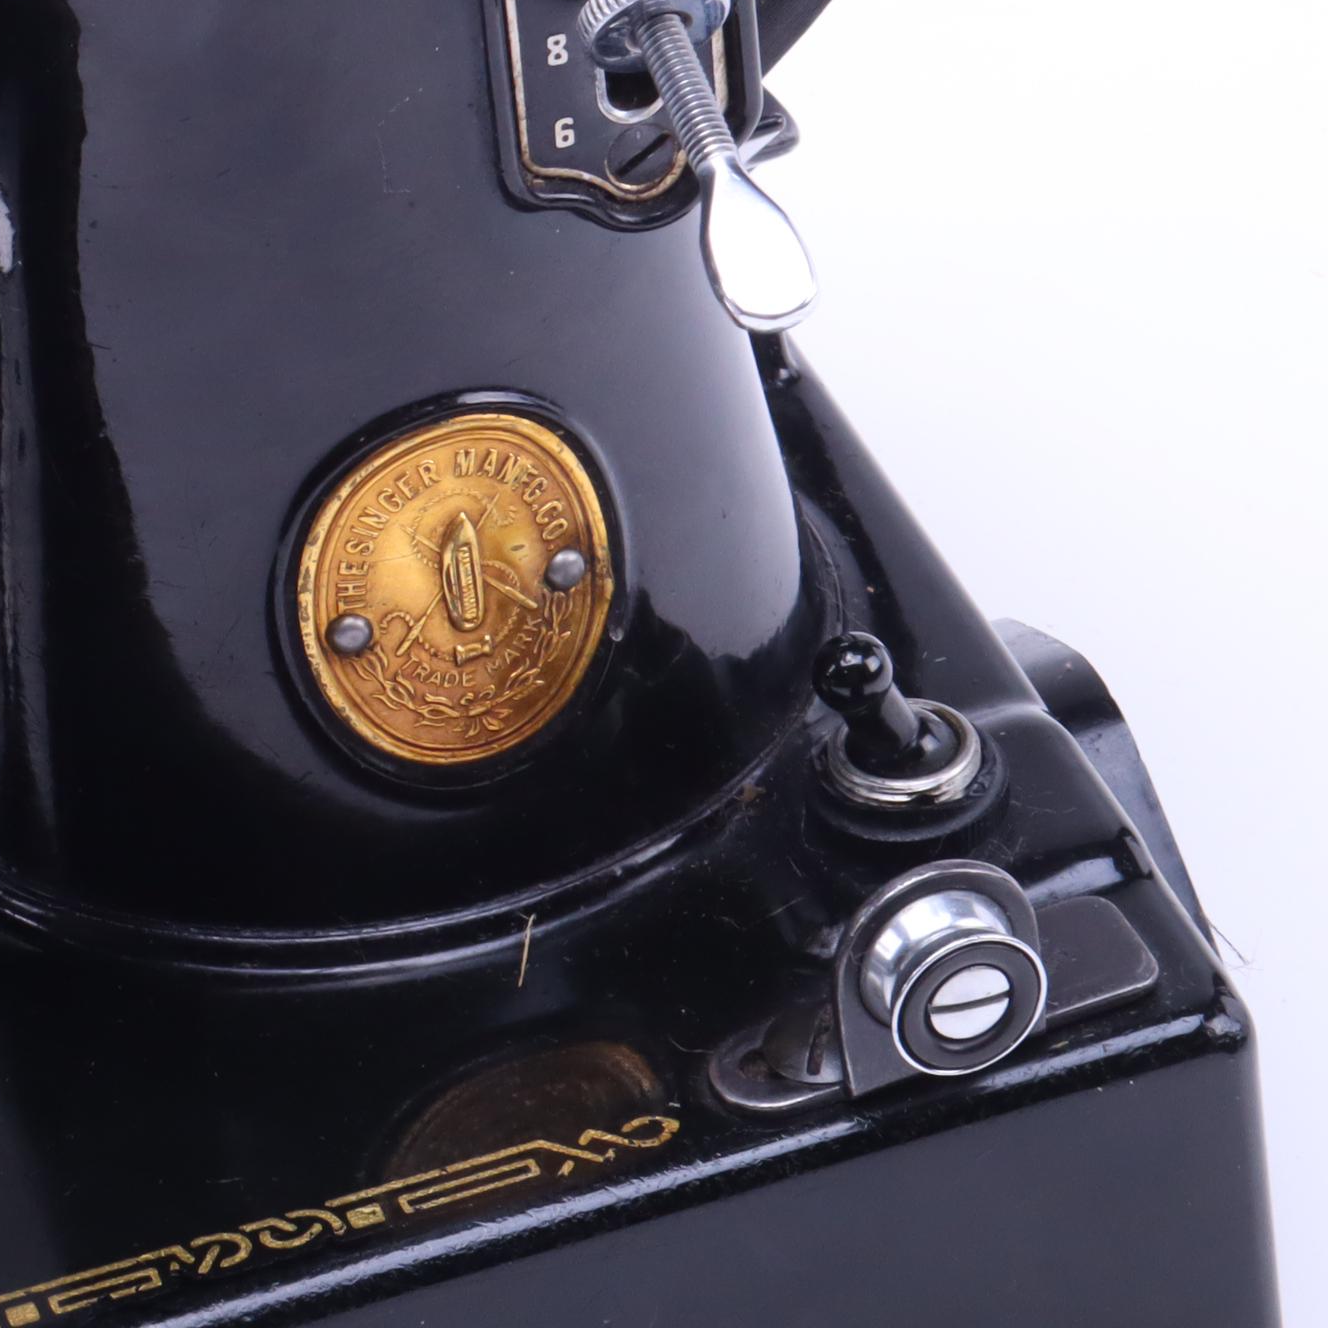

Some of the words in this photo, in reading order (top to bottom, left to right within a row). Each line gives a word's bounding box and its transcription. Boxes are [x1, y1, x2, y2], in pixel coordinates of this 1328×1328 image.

[547, 33, 568, 66] 8
[554, 117, 575, 149] 6
[345, 459, 441, 556] SINGER
[336, 560, 370, 613] THE
[402, 651, 476, 687] TRADE
[485, 615, 542, 675] MARK
